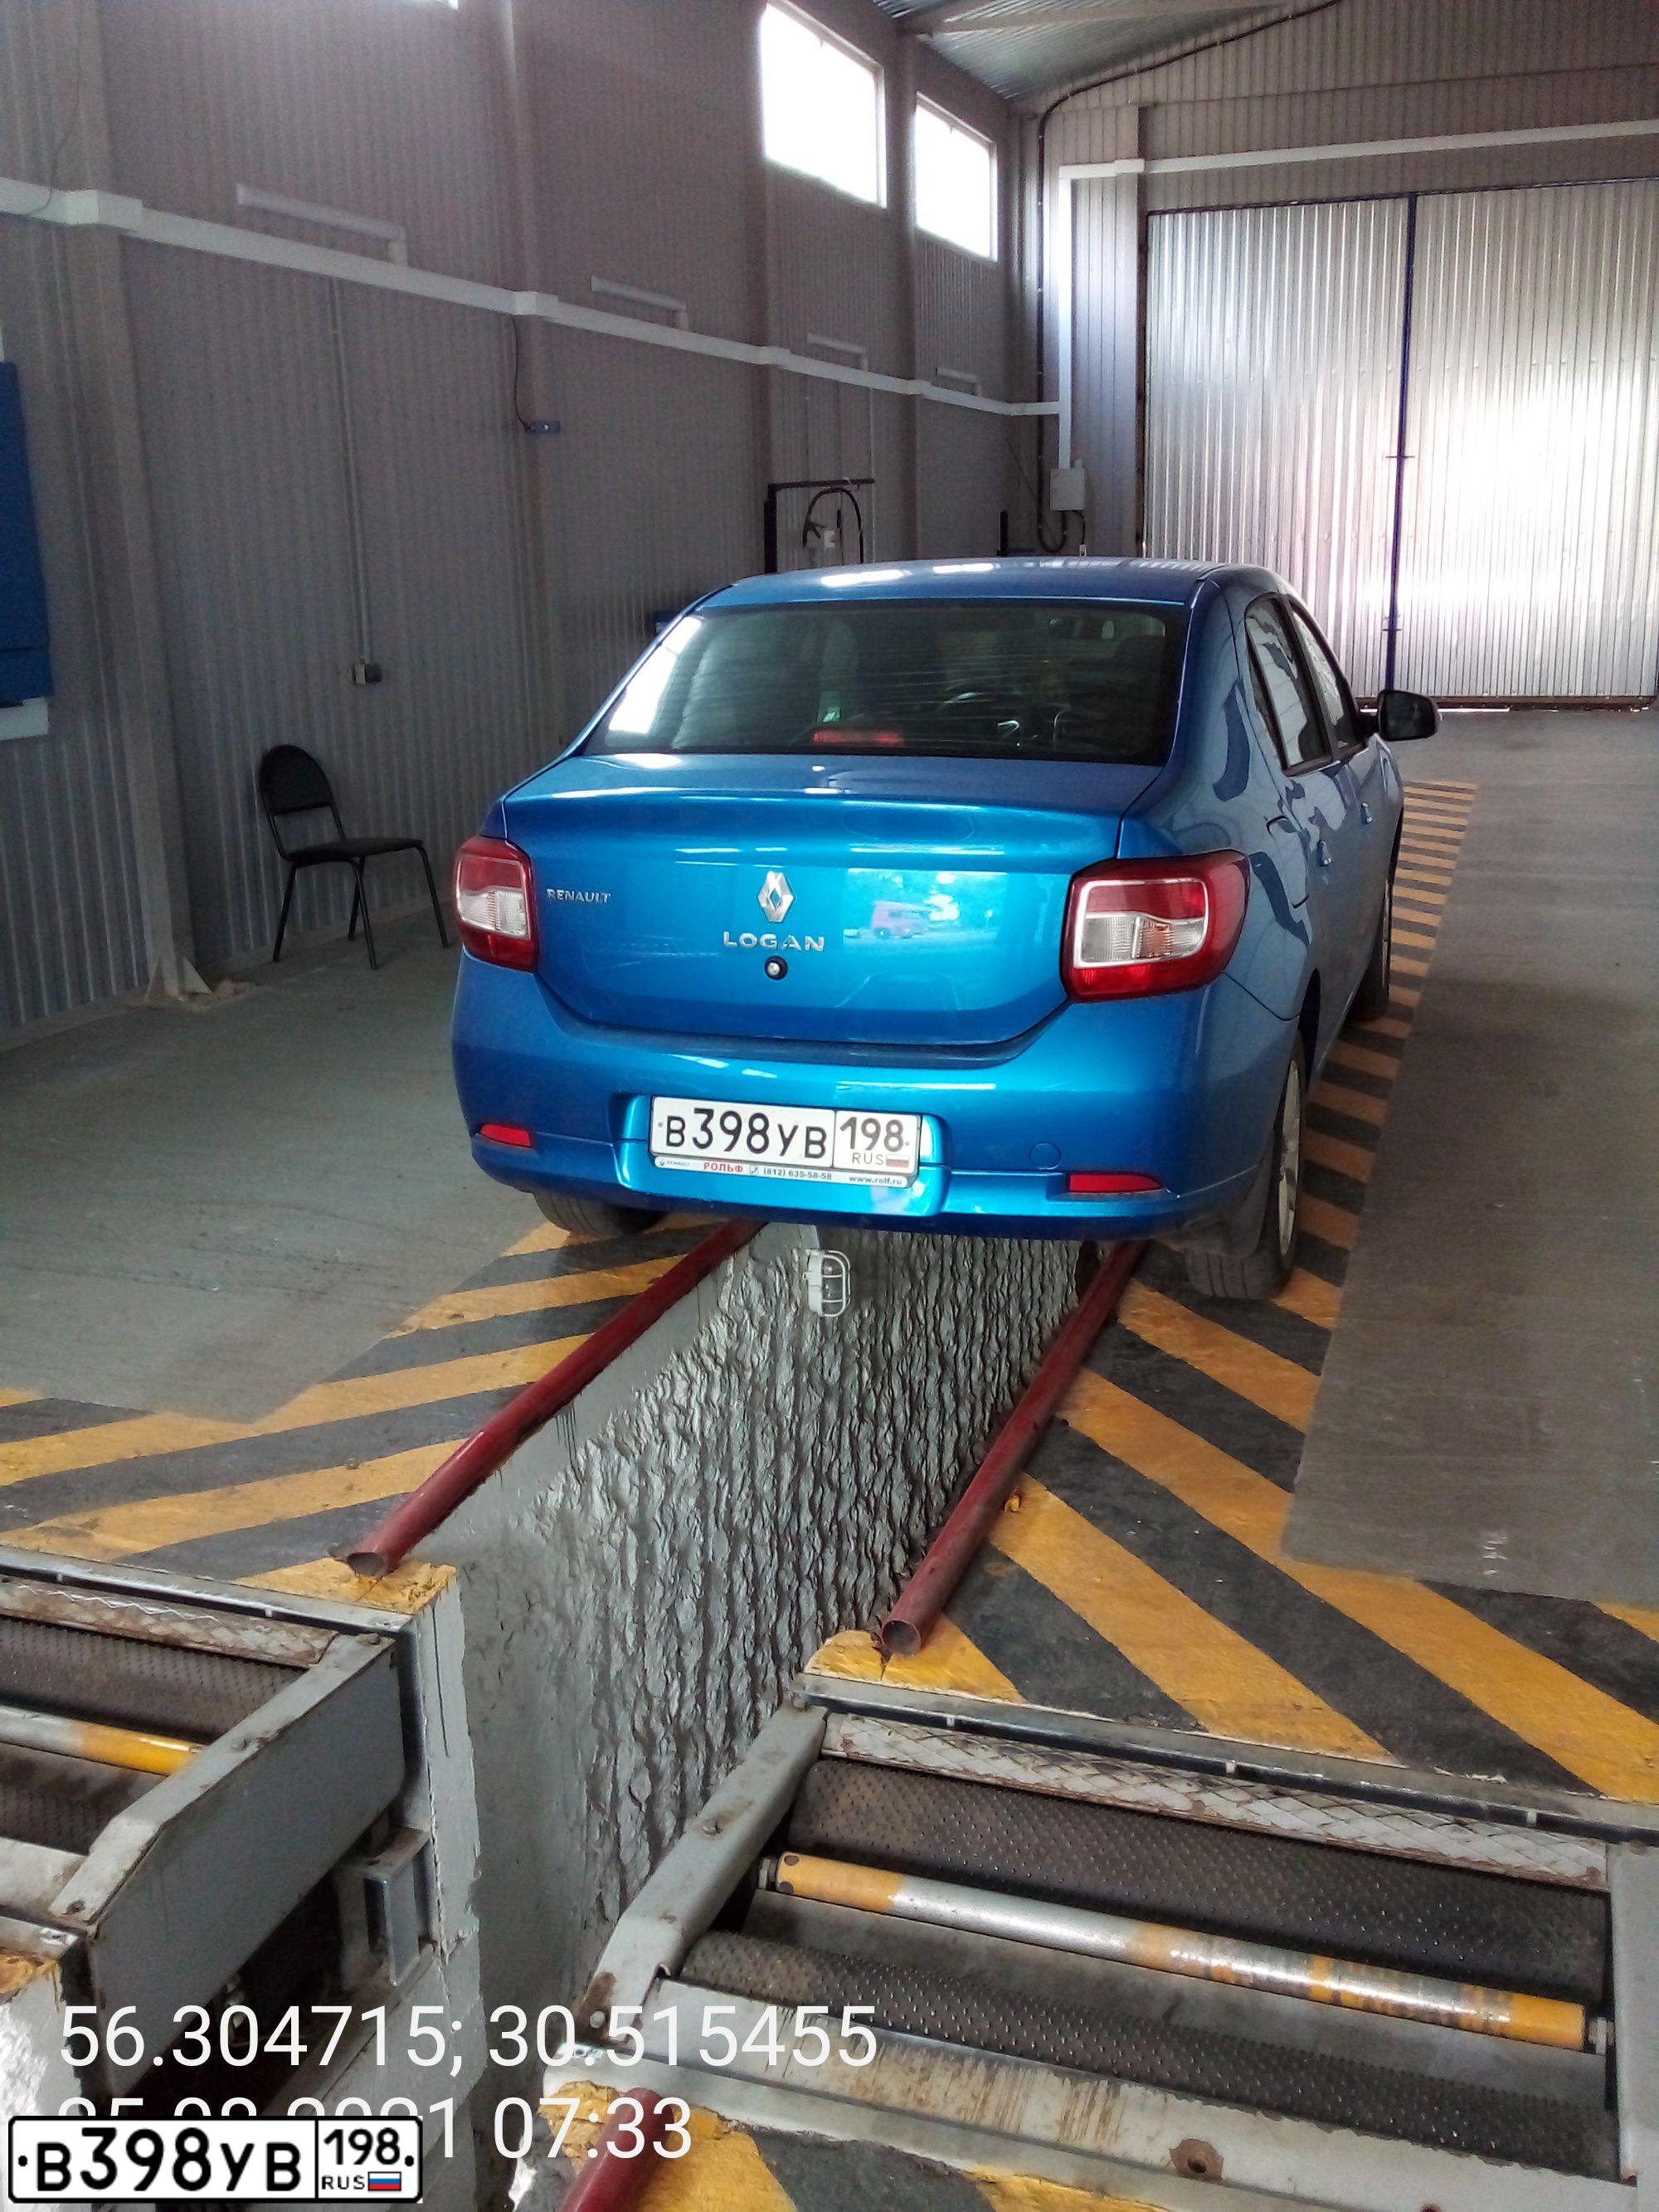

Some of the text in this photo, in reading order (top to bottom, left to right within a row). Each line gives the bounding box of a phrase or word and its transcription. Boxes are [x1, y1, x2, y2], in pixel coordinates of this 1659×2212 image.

[546, 888, 611, 904] RENAULT
[722, 930, 825, 953] LOGAN
[839, 1115, 904, 1152] 198
[851, 1152, 885, 1167] RUS
[703, 1161, 833, 1181] РОЛЬФ (812) 635-58-58
[849, 1175, 903, 1186] www.rolf.ru
